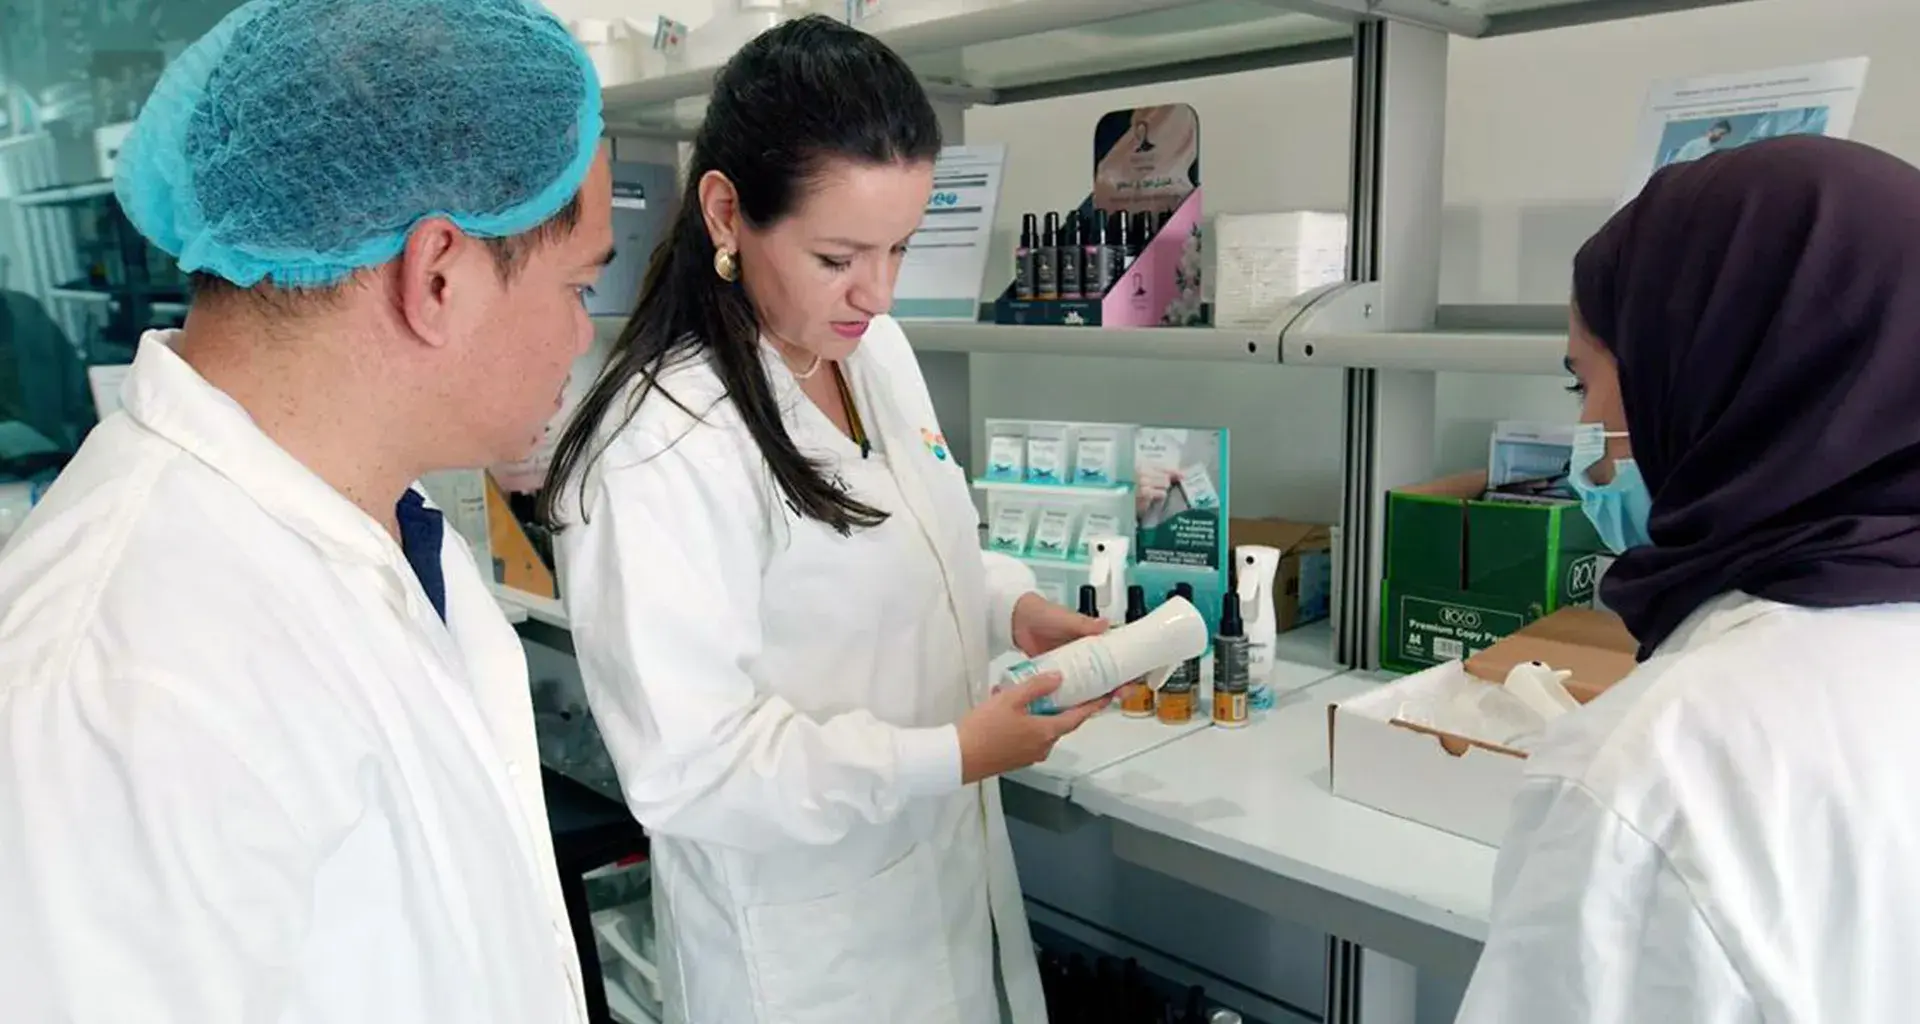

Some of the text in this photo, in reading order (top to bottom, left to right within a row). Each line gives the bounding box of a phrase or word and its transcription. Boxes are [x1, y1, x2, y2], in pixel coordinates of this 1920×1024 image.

[1409, 619, 1499, 643] Premium Copy Pa
[1409, 633, 1421, 645] A4
